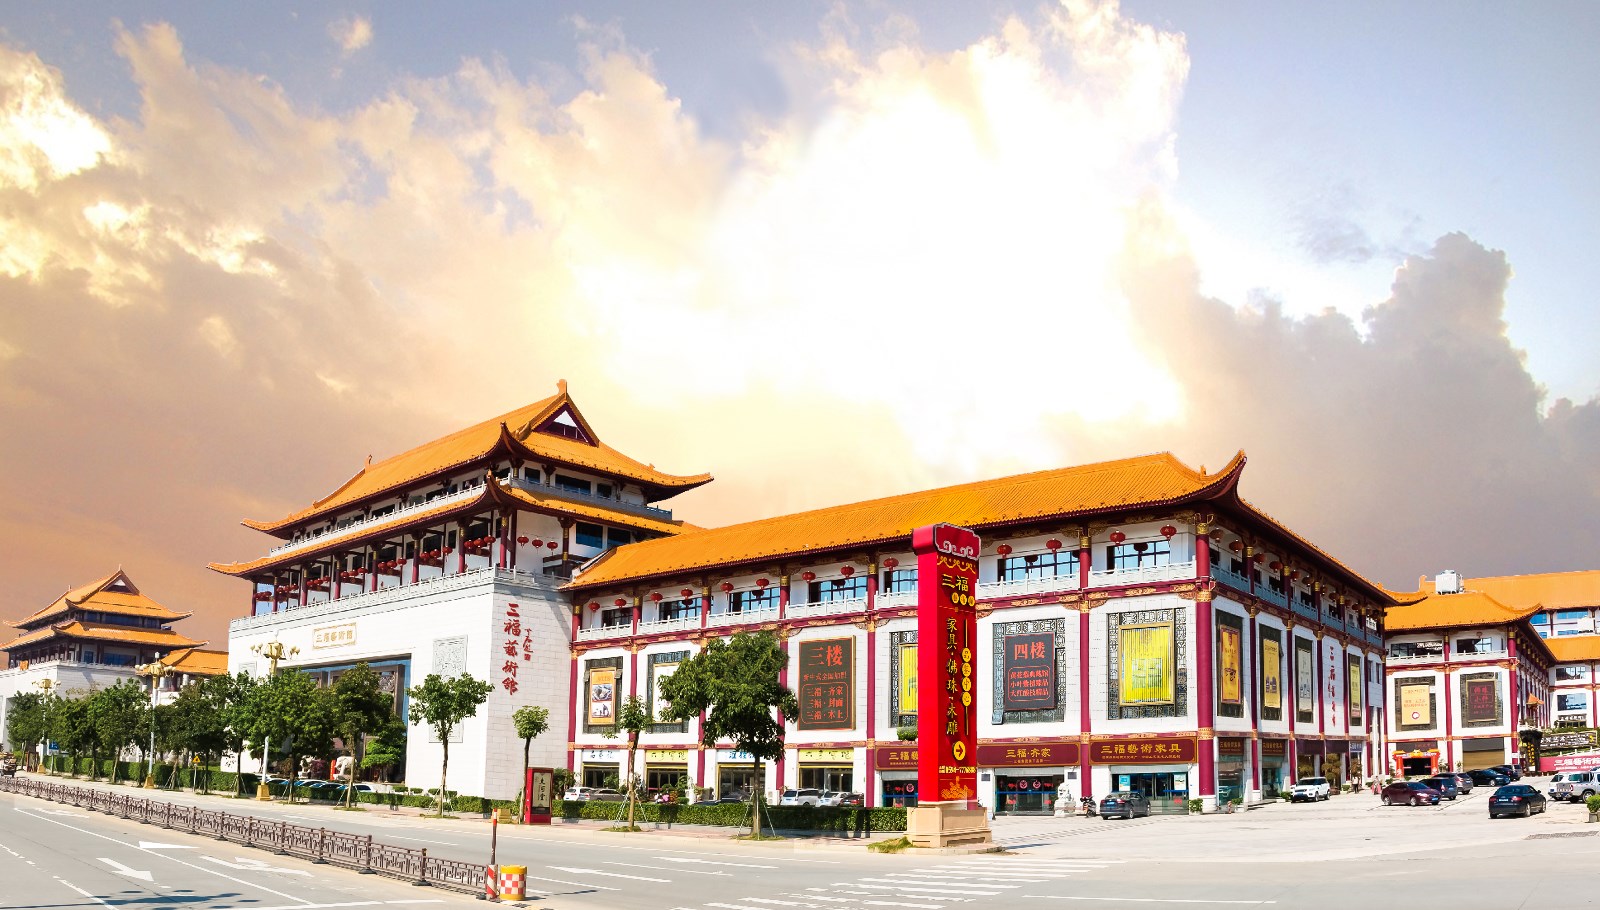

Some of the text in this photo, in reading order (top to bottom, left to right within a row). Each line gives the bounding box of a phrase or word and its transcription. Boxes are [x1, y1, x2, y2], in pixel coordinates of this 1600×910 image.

[941, 574, 969, 592] 三福
[807, 645, 843, 667] 三楼
[1013, 641, 1046, 660] 四楼
[1005, 747, 1051, 758] 三福·齐家
